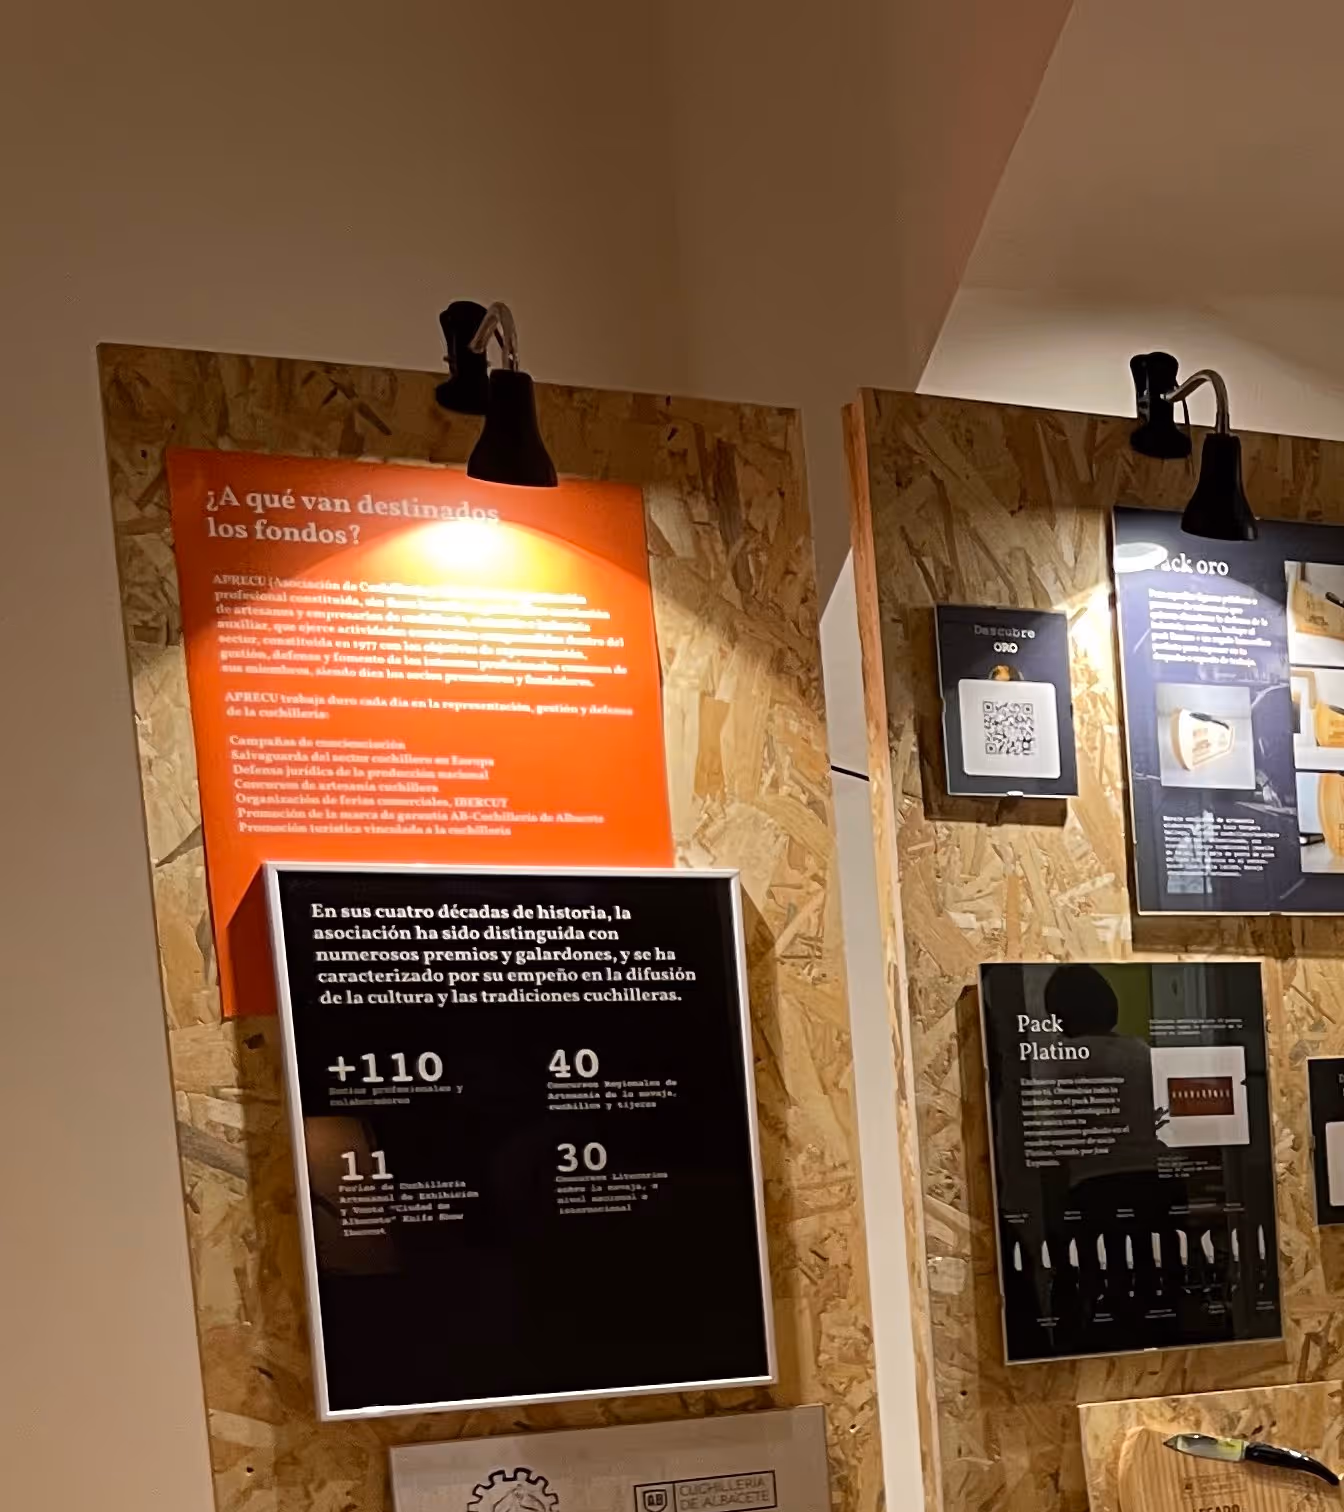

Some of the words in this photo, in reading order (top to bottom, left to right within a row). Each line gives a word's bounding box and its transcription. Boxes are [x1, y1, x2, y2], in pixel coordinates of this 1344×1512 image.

[206, 486, 239, 512] ¿A
[245, 490, 295, 513] qué
[301, 496, 351, 513] van
[358, 496, 499, 523] destinados
[208, 518, 247, 541] los
[255, 520, 361, 545] fondos?
[1155, 553, 1193, 573] ack
[1196, 560, 1229, 575] oro
[993, 642, 1018, 653] ORO
[312, 903, 337, 919] En
[341, 908, 371, 919] sus
[375, 903, 434, 919] cuatro
[438, 904, 509, 920] décadas
[513, 904, 534, 920] de
[538, 904, 611, 924] historia,
[616, 905, 631, 920] la
[313, 925, 411, 940] asociación
[416, 925, 438, 941] ha
[442, 925, 480, 941] sido
[484, 925, 584, 944] distinguida
[589, 930, 618, 941] con
[316, 950, 419, 962] numerosos
[424, 946, 497, 965] premios
[501, 950, 512, 965] y
[516, 945, 617, 965] galardones,
[620, 950, 630, 964] y
[634, 950, 651, 961] se
[655, 945, 675, 961] ha
[318, 967, 443, 983] caracterizado
[449, 971, 480, 986] por
[484, 971, 503, 982] su
[507, 966, 578, 985] empeño
[582, 970, 602, 981] en
[606, 966, 622, 981] la
[626, 965, 696, 981] difusión
[320, 990, 342, 1005] de
[346, 989, 363, 1005] la
[368, 989, 435, 1005] cultura
[438, 993, 448, 1008] y
[451, 988, 477, 1004] las
[482, 987, 579, 1004] tradiciones
[584, 986, 681, 1003] cuchilleras.
[1017, 1014, 1064, 1033] Pack
[1019, 1042, 1090, 1060] Platino
[328, 1051, 443, 1083] +110
[548, 1048, 599, 1078] 40
[340, 1149, 394, 1181] 11
[555, 1142, 607, 1172] 30
